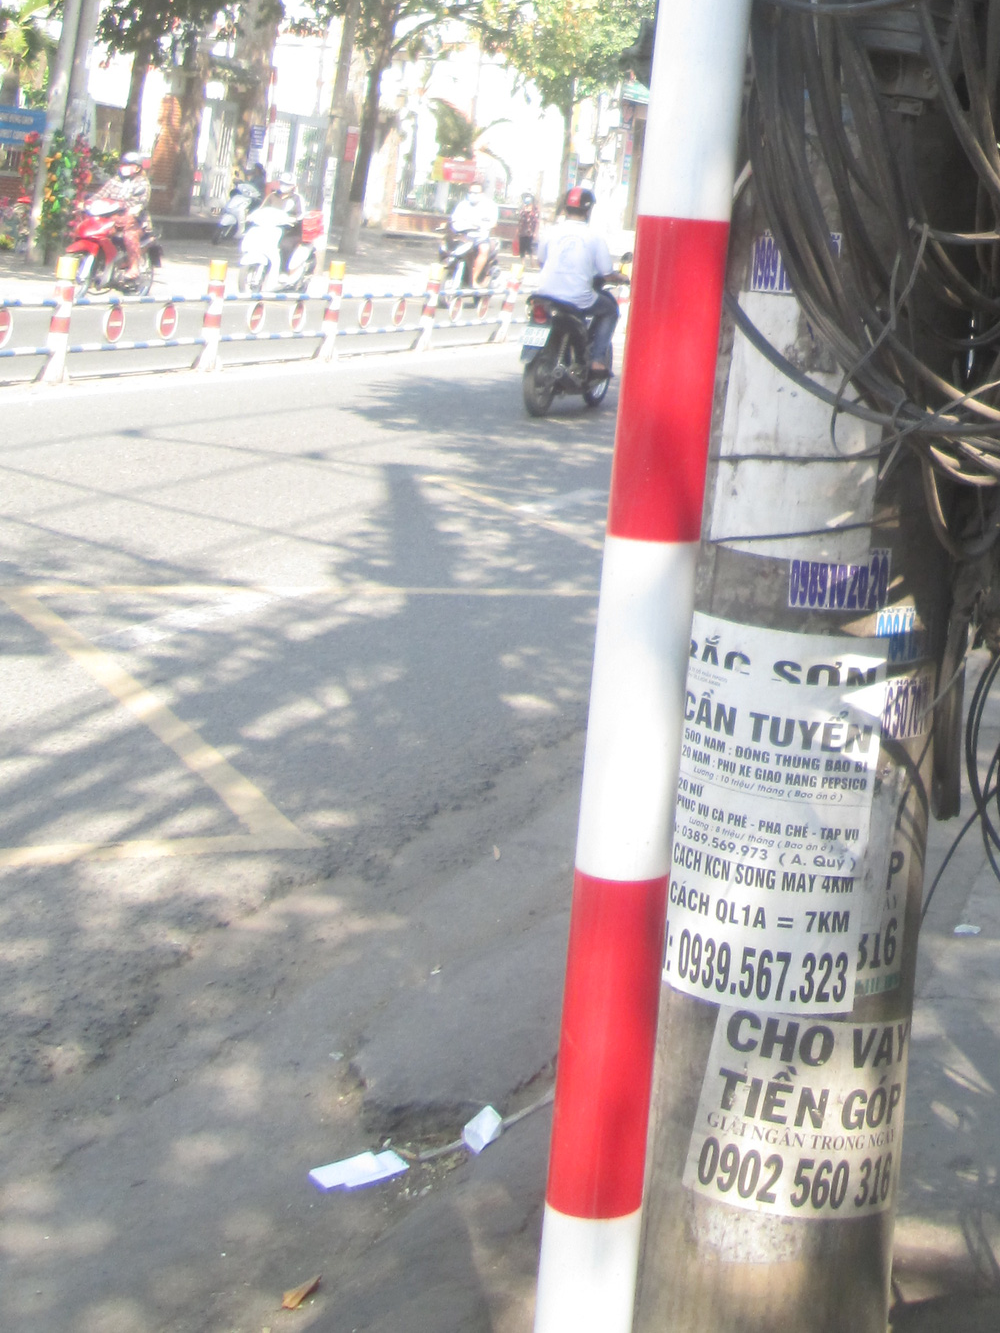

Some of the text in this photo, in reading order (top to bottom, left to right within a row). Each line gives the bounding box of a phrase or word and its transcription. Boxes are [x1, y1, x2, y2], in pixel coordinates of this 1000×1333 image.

[685, 728, 700, 744] 500
[704, 735, 725, 753] NAM
[824, 759, 850, 772] BAO
[750, 711, 873, 754] TUYỂN
[678, 777, 688, 791] 20
[682, 744, 691, 757] 20
[692, 748, 710, 765] NAM
[739, 765, 751, 778] XE
[755, 768, 782, 783] GIAO
[821, 777, 867, 790] PEPSICO
[720, 774, 729, 784] 10
[794, 790, 813, 799] Bao
[682, 825, 768, 861] 0389.569.973
[813, 853, 845, 871] Quý
[758, 820, 781, 835] PHA
[784, 841, 803, 850] Bao
[705, 855, 855, 894] KCN 4KM
[670, 880, 709, 916] CÁCH
[715, 898, 766, 929] QL1A
[805, 911, 849, 933] 7KM
[678, 928, 849, 1003] 0939.567.323
[727, 1010, 908, 1069] CHO VAY
[719, 1064, 901, 1131] TIỀN GÓP
[751, 1125, 865, 1150] NGÂN TRONG
[698, 1136, 892, 1209] 0902 560 316
